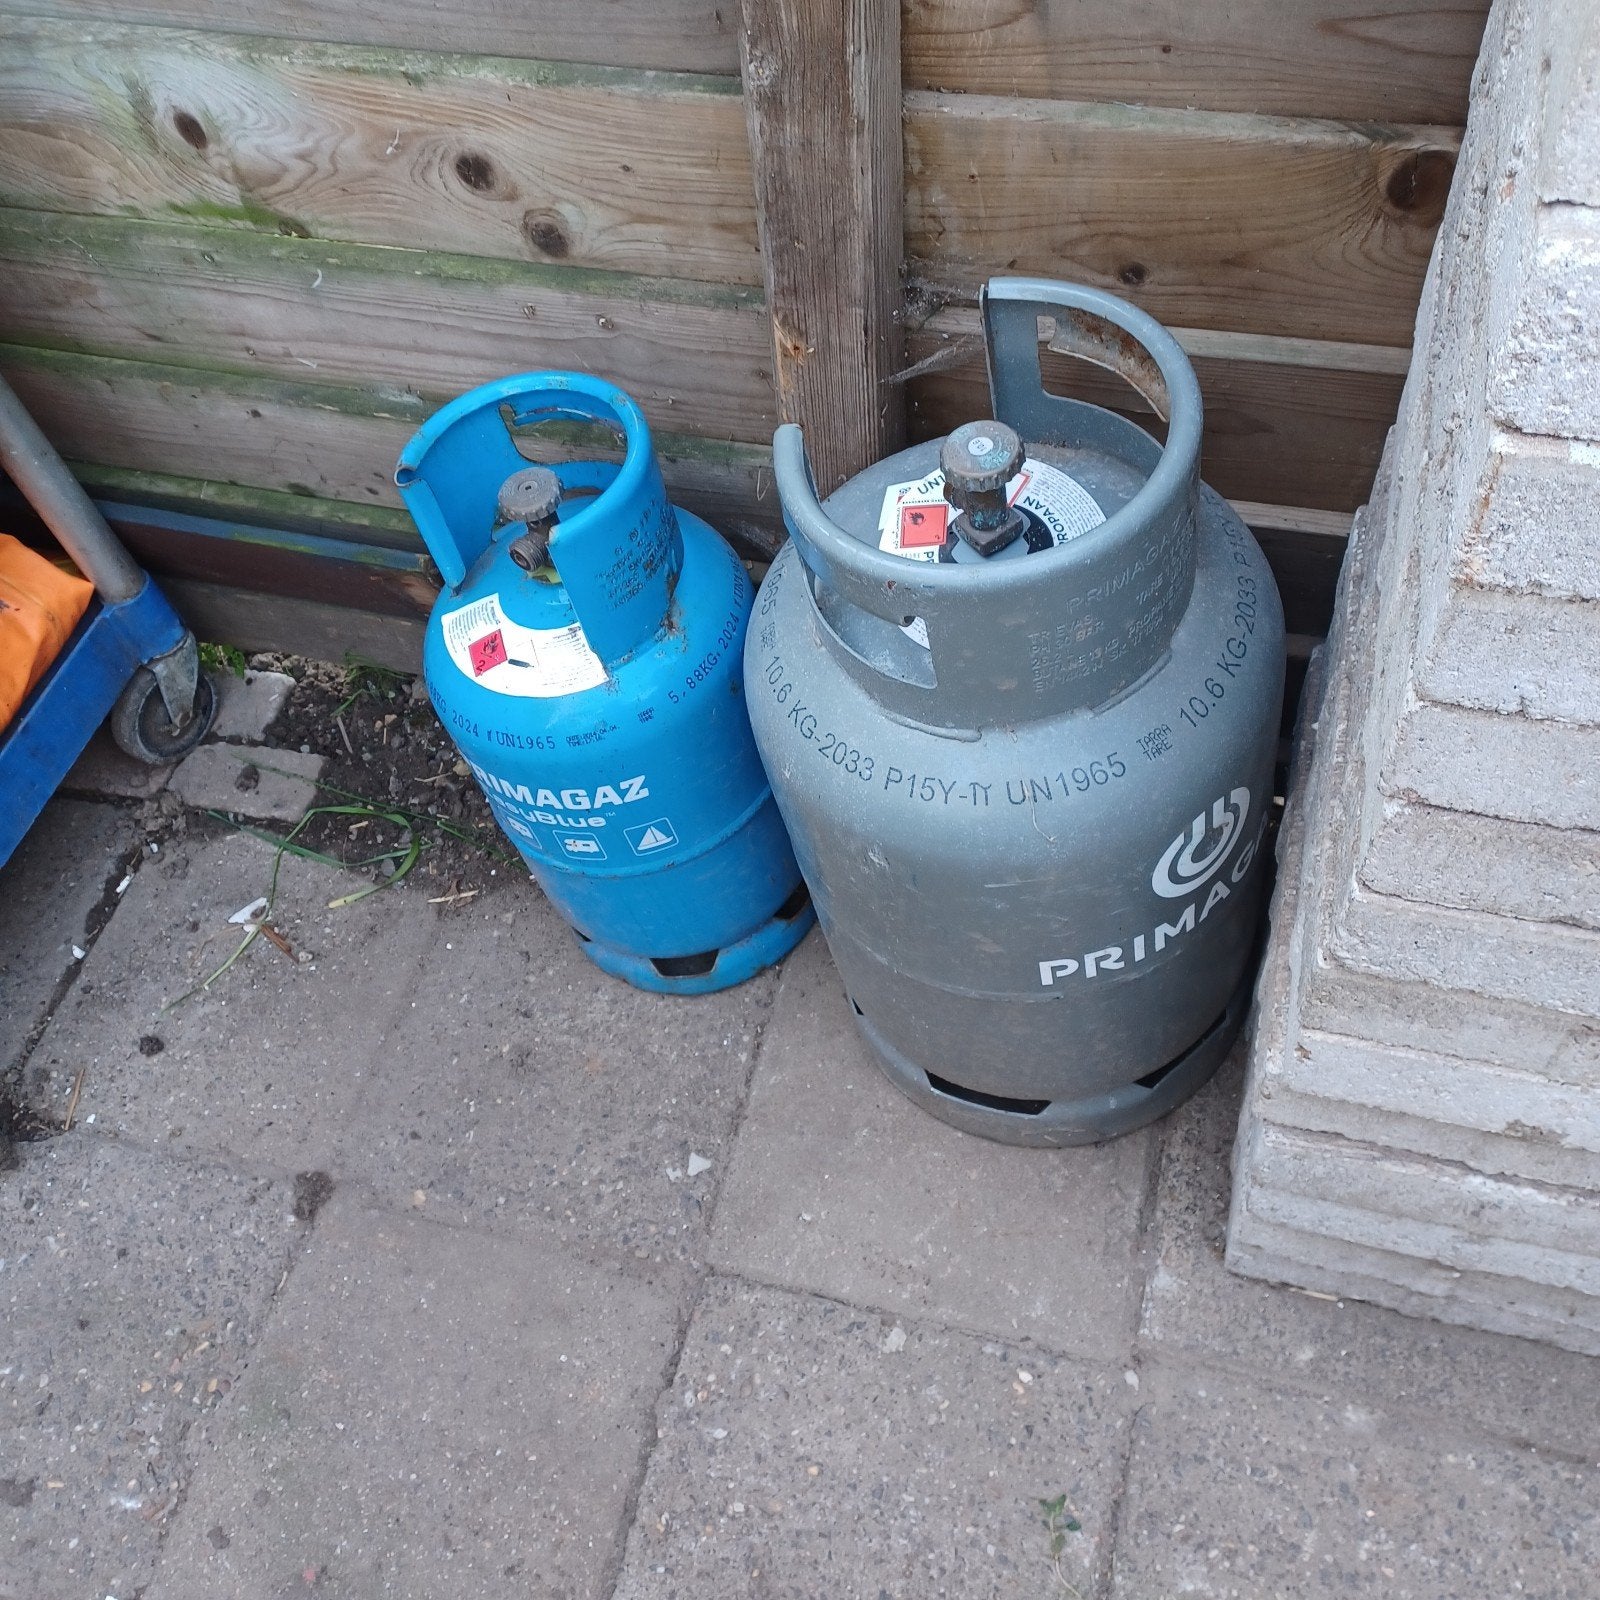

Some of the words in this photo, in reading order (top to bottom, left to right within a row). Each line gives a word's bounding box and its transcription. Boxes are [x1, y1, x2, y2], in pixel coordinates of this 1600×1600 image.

[1023, 496, 1069, 546] ROPAAN
[764, 655, 792, 703] 10.6
[787, 699, 874, 782] KG-2033
[1006, 751, 1126, 806] UN1965
[1179, 677, 1225, 728] 10.6
[1217, 575, 1257, 678] KG-2033
[452, 710, 480, 738] 2024
[495, 730, 556, 750] UN1965
[1136, 723, 1172, 751] TARRA
[1142, 739, 1173, 762] TARE
[470, 759, 650, 811] RIMAGAZ
